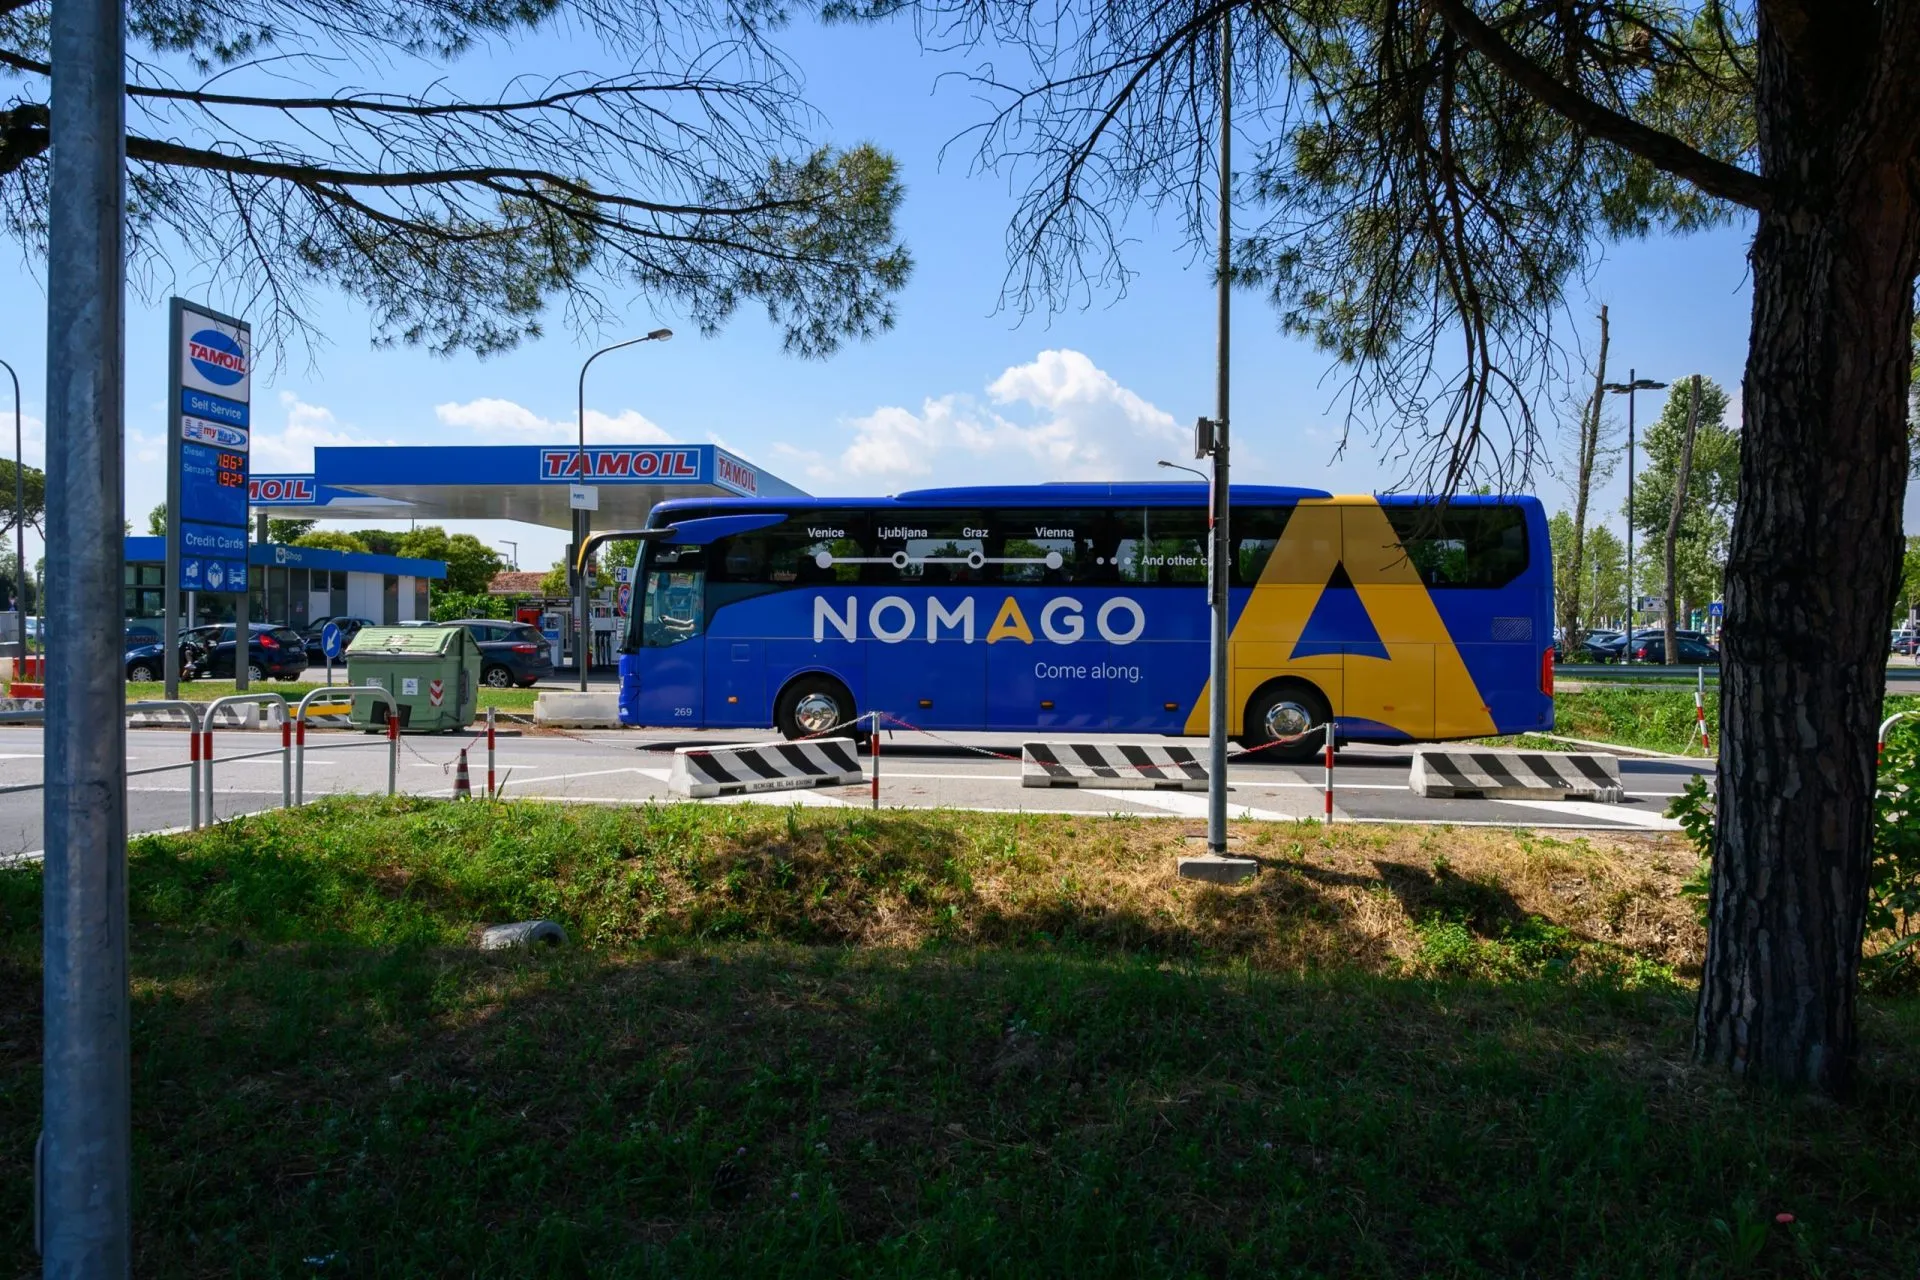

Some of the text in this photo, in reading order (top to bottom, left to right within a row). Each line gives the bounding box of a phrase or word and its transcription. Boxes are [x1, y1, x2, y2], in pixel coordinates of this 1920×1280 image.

[189, 342, 246, 373] TAMOIL
[191, 396, 242, 419] Self Service
[183, 445, 205, 457] Diesel
[183, 463, 205, 475] Senza
[544, 451, 697, 476] TAMOIL
[718, 456, 756, 492] TAMOIL
[807, 527, 845, 538] Venice
[877, 527, 928, 540] Ljubljana
[962, 527, 989, 538] Graz
[1035, 526, 1075, 538] Vienna
[185, 533, 244, 550] Credit Cards
[1141, 555, 1164, 566] And
[1169, 555, 1196, 566] other
[813, 595, 1146, 645] NOMAGO
[1034, 661, 1144, 683] Come along.
[674, 707, 693, 717] 269
